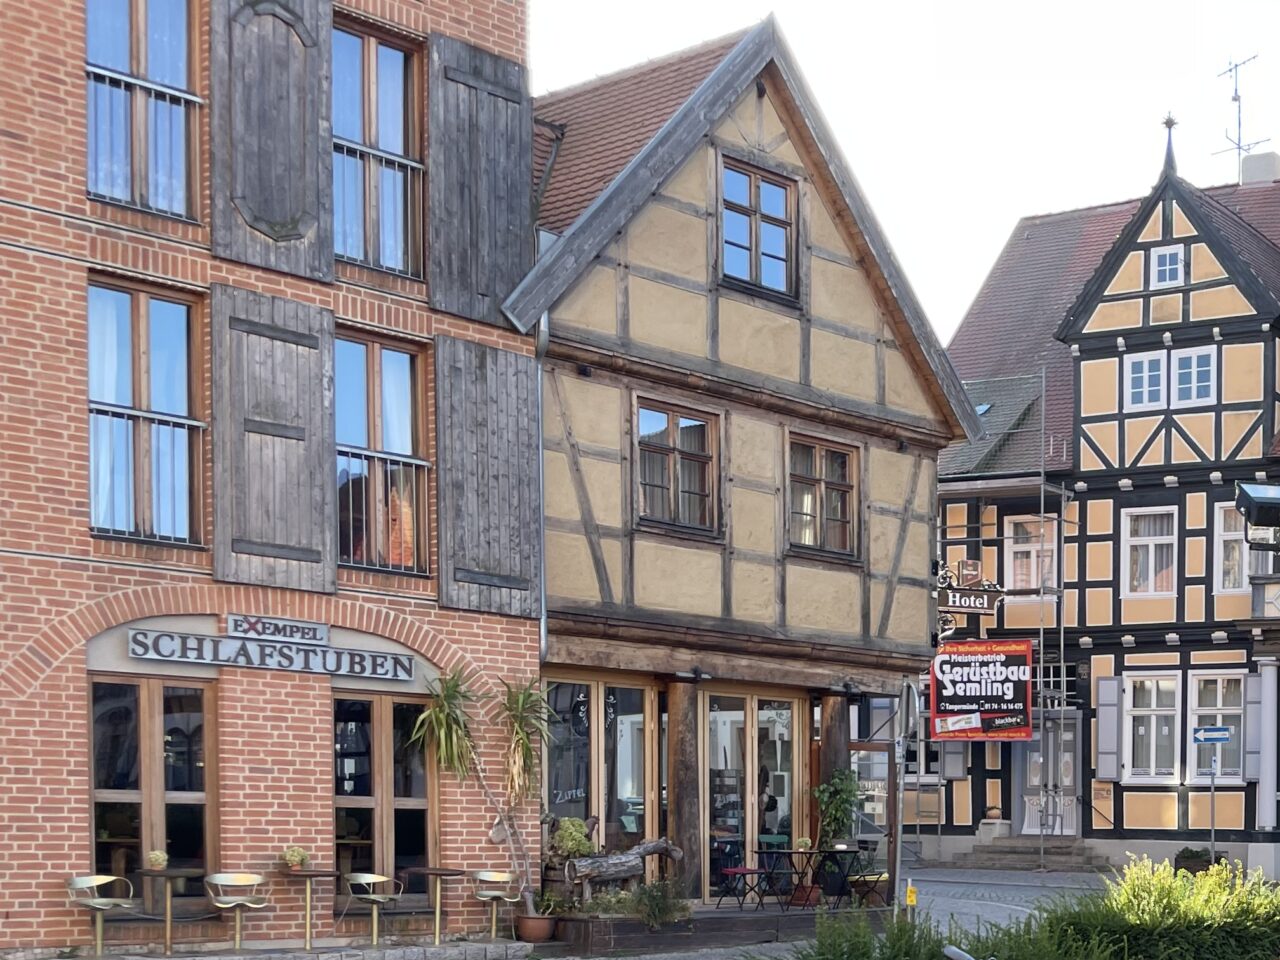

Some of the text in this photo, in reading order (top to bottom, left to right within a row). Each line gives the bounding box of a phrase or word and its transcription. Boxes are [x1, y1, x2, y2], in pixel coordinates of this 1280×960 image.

[948, 593, 988, 608] Hotel
[233, 615, 324, 641] EXEMPEL
[131, 631, 414, 679] SCHLAFSTUBEN
[934, 655, 1030, 681] Gerüstbau
[951, 653, 1006, 662] Meisterbetrieb
[942, 673, 1014, 700] Semling
